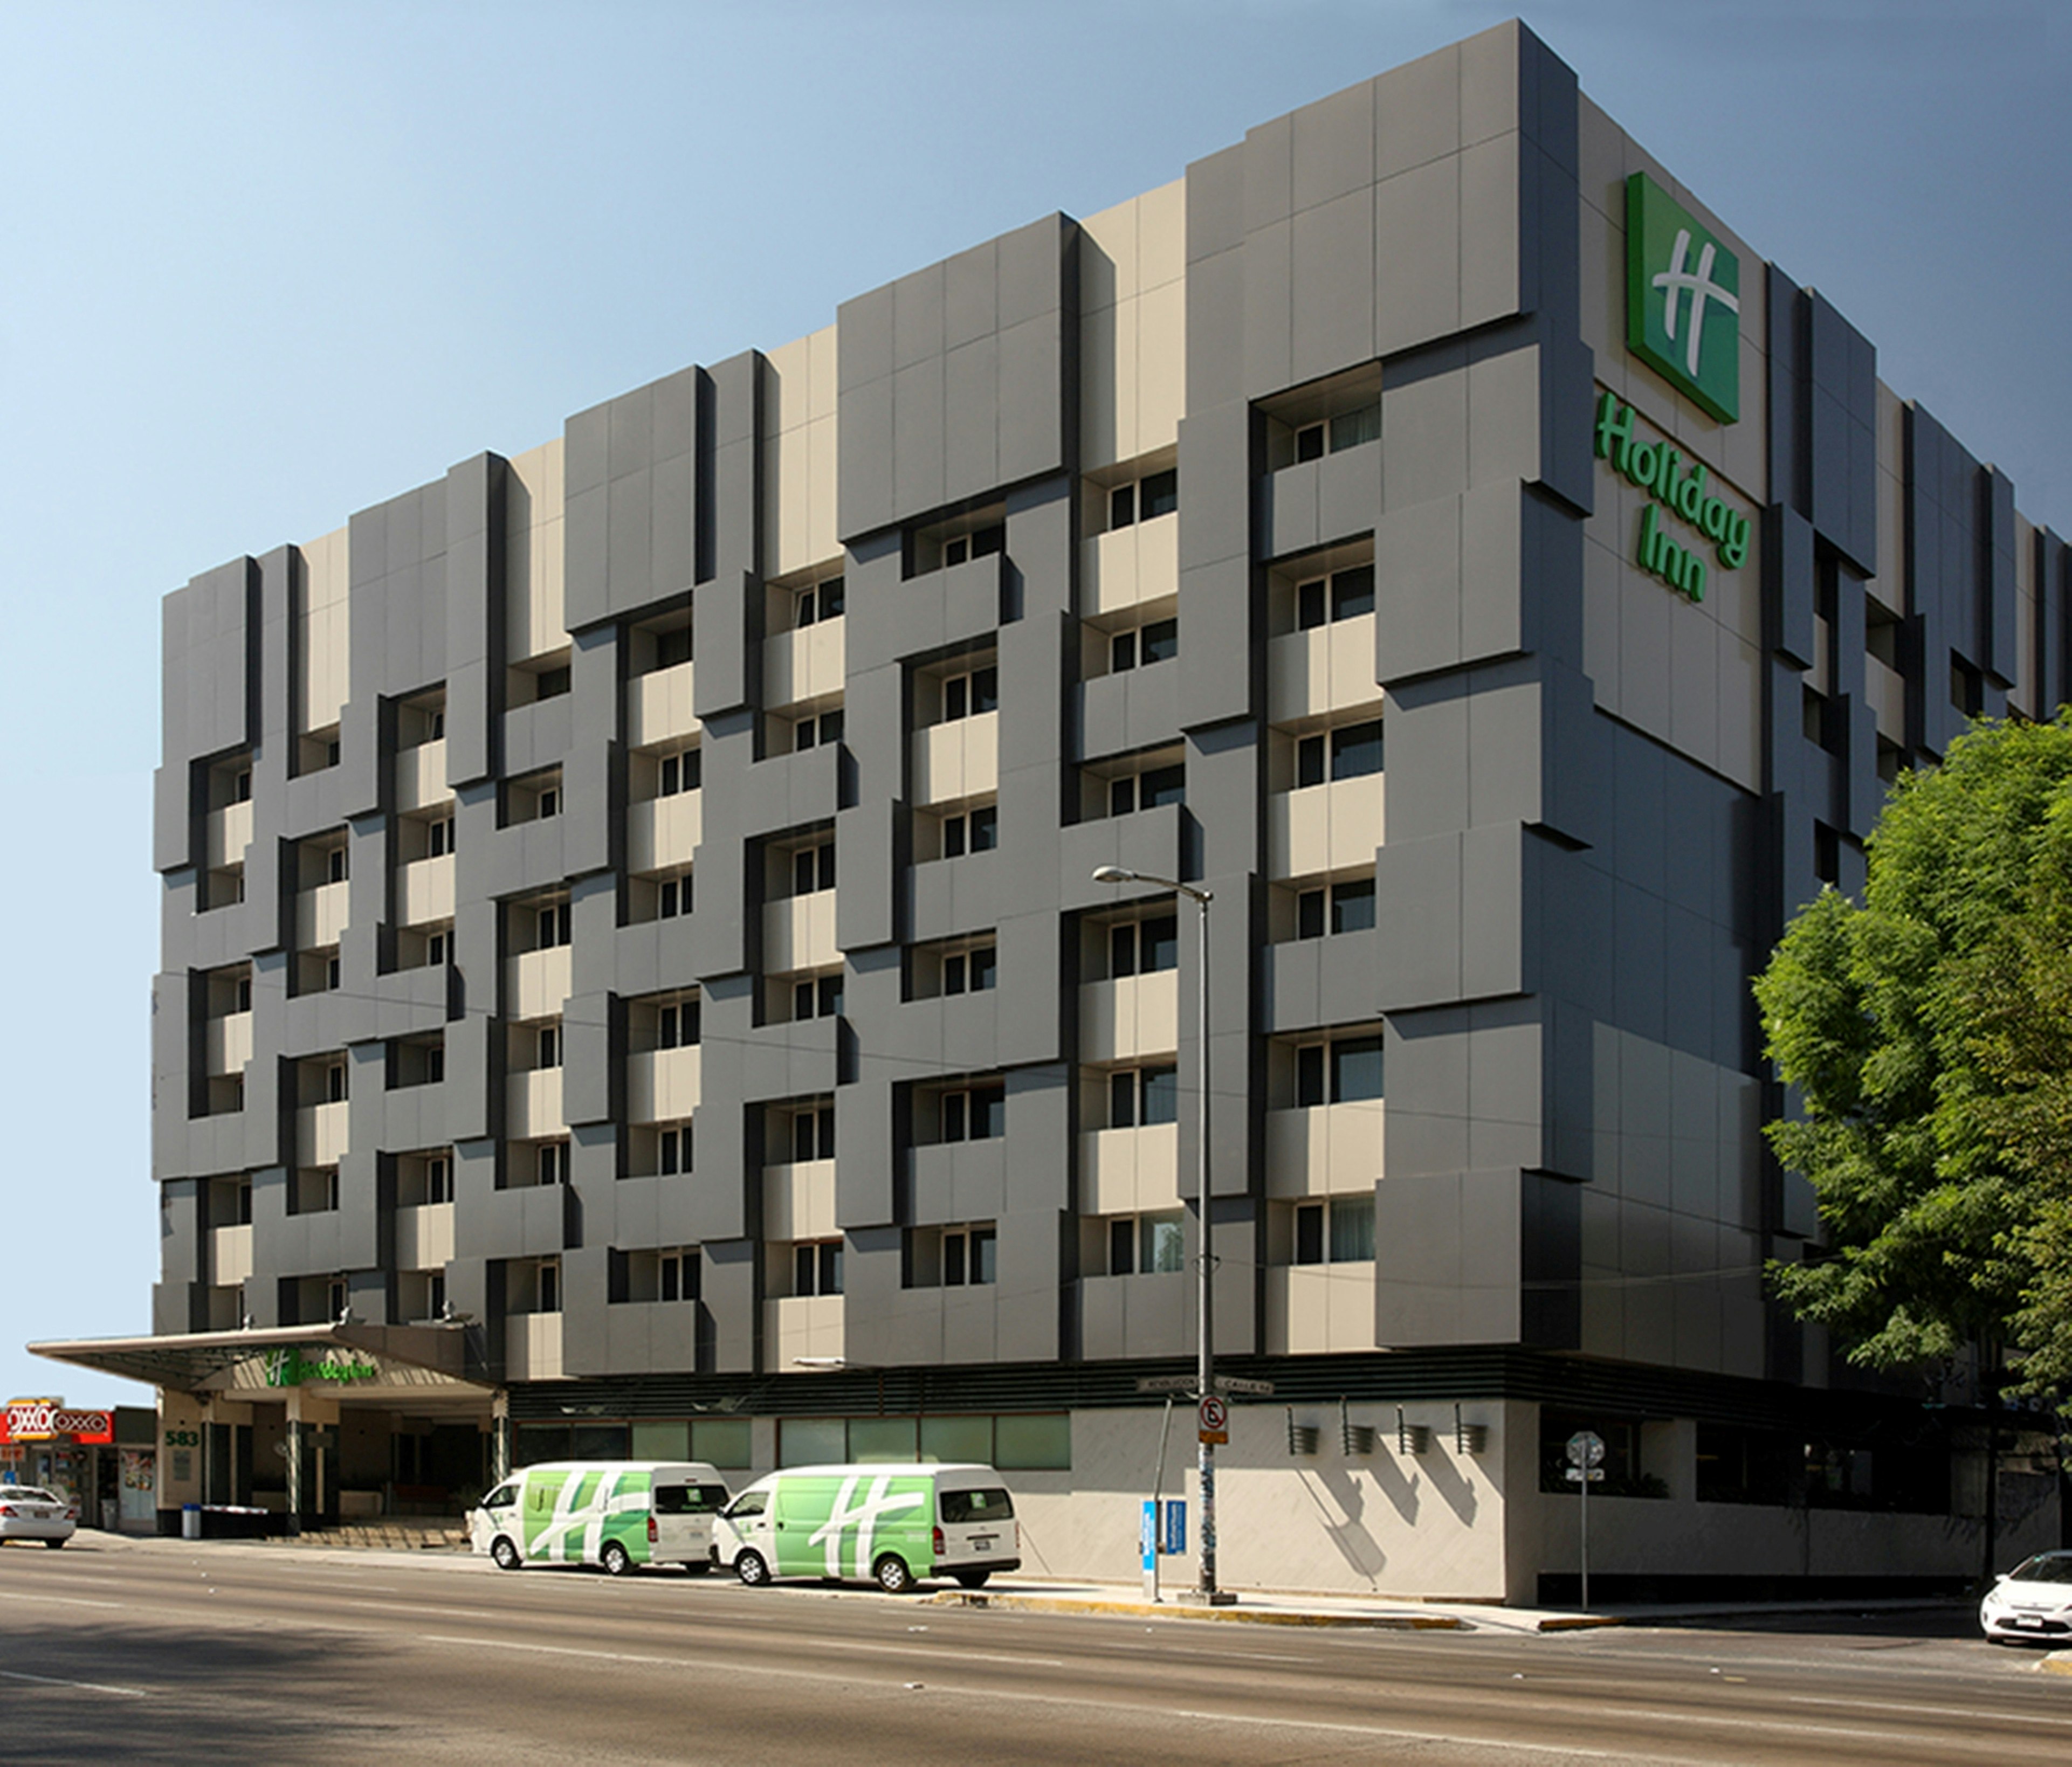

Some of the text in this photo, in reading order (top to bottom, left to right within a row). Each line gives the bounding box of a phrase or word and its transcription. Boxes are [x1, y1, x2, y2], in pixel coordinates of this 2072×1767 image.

[1594, 391, 1751, 570] Holiday
[1637, 502, 1707, 603] Inn
[1224, 1379, 1255, 1390] CALLE
[8, 1407, 50, 1432] OXXO
[54, 1414, 106, 1431] OXXO
[166, 1431, 198, 1447] 583
